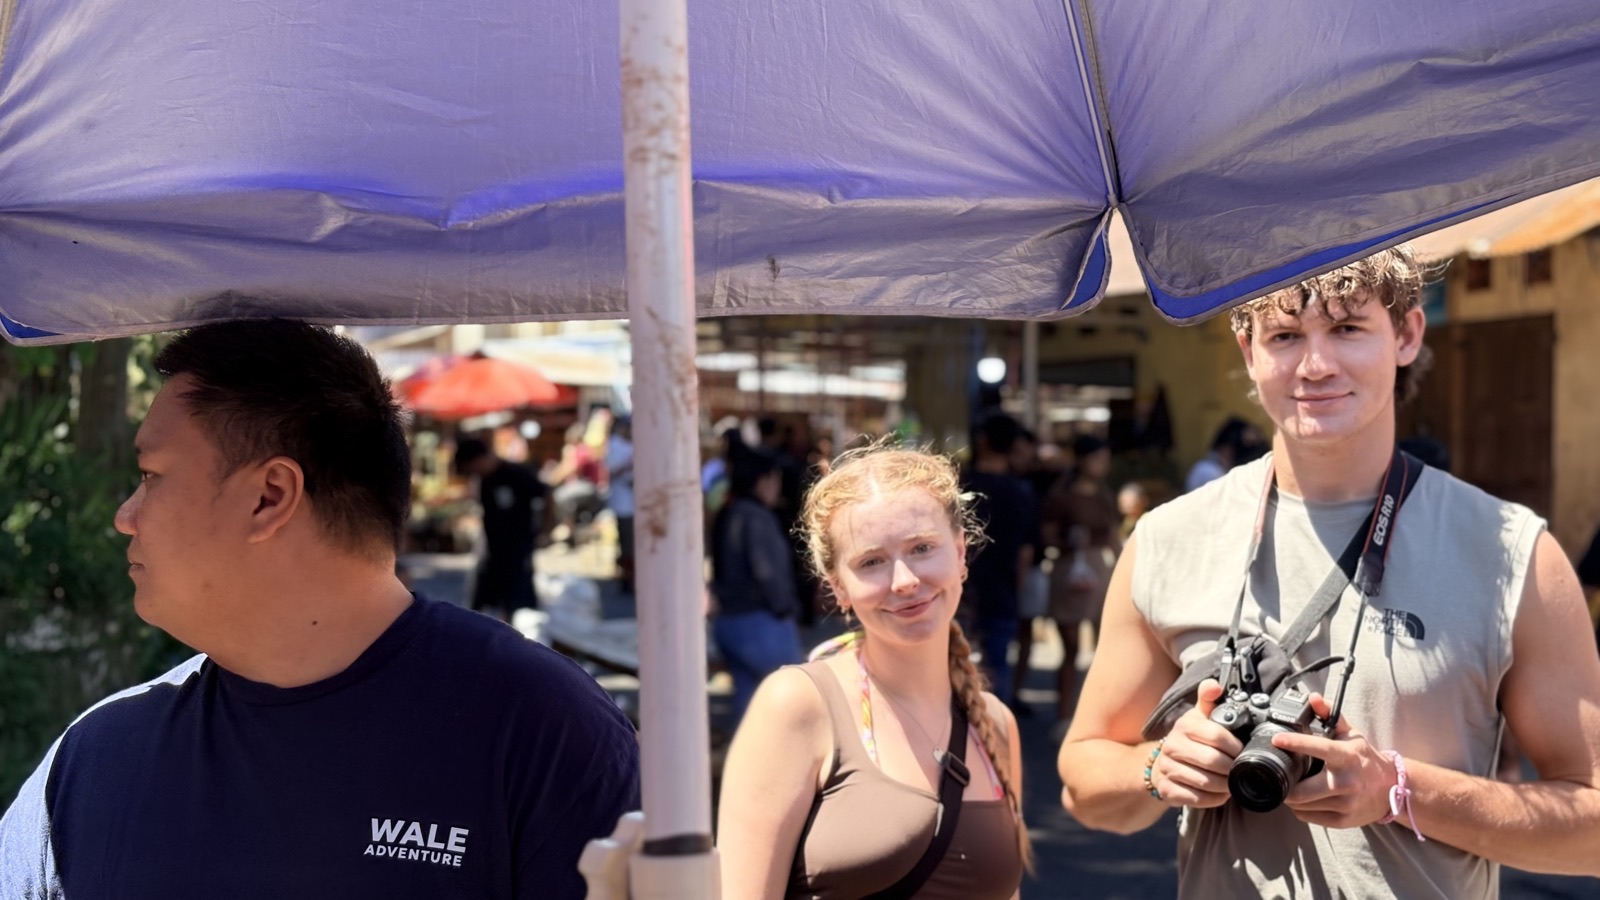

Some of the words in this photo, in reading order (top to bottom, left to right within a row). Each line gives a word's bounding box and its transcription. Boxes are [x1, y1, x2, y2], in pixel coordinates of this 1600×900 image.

[1373, 513, 1389, 546] EOS
[1381, 494, 1394, 517] R10
[1384, 608, 1406, 619] THE
[1364, 615, 1405, 628] NORTH
[1374, 624, 1403, 637] FACE
[1271, 711, 1296, 723] Canon
[371, 817, 470, 853] WALE
[363, 844, 462, 867] ADVENTURE
